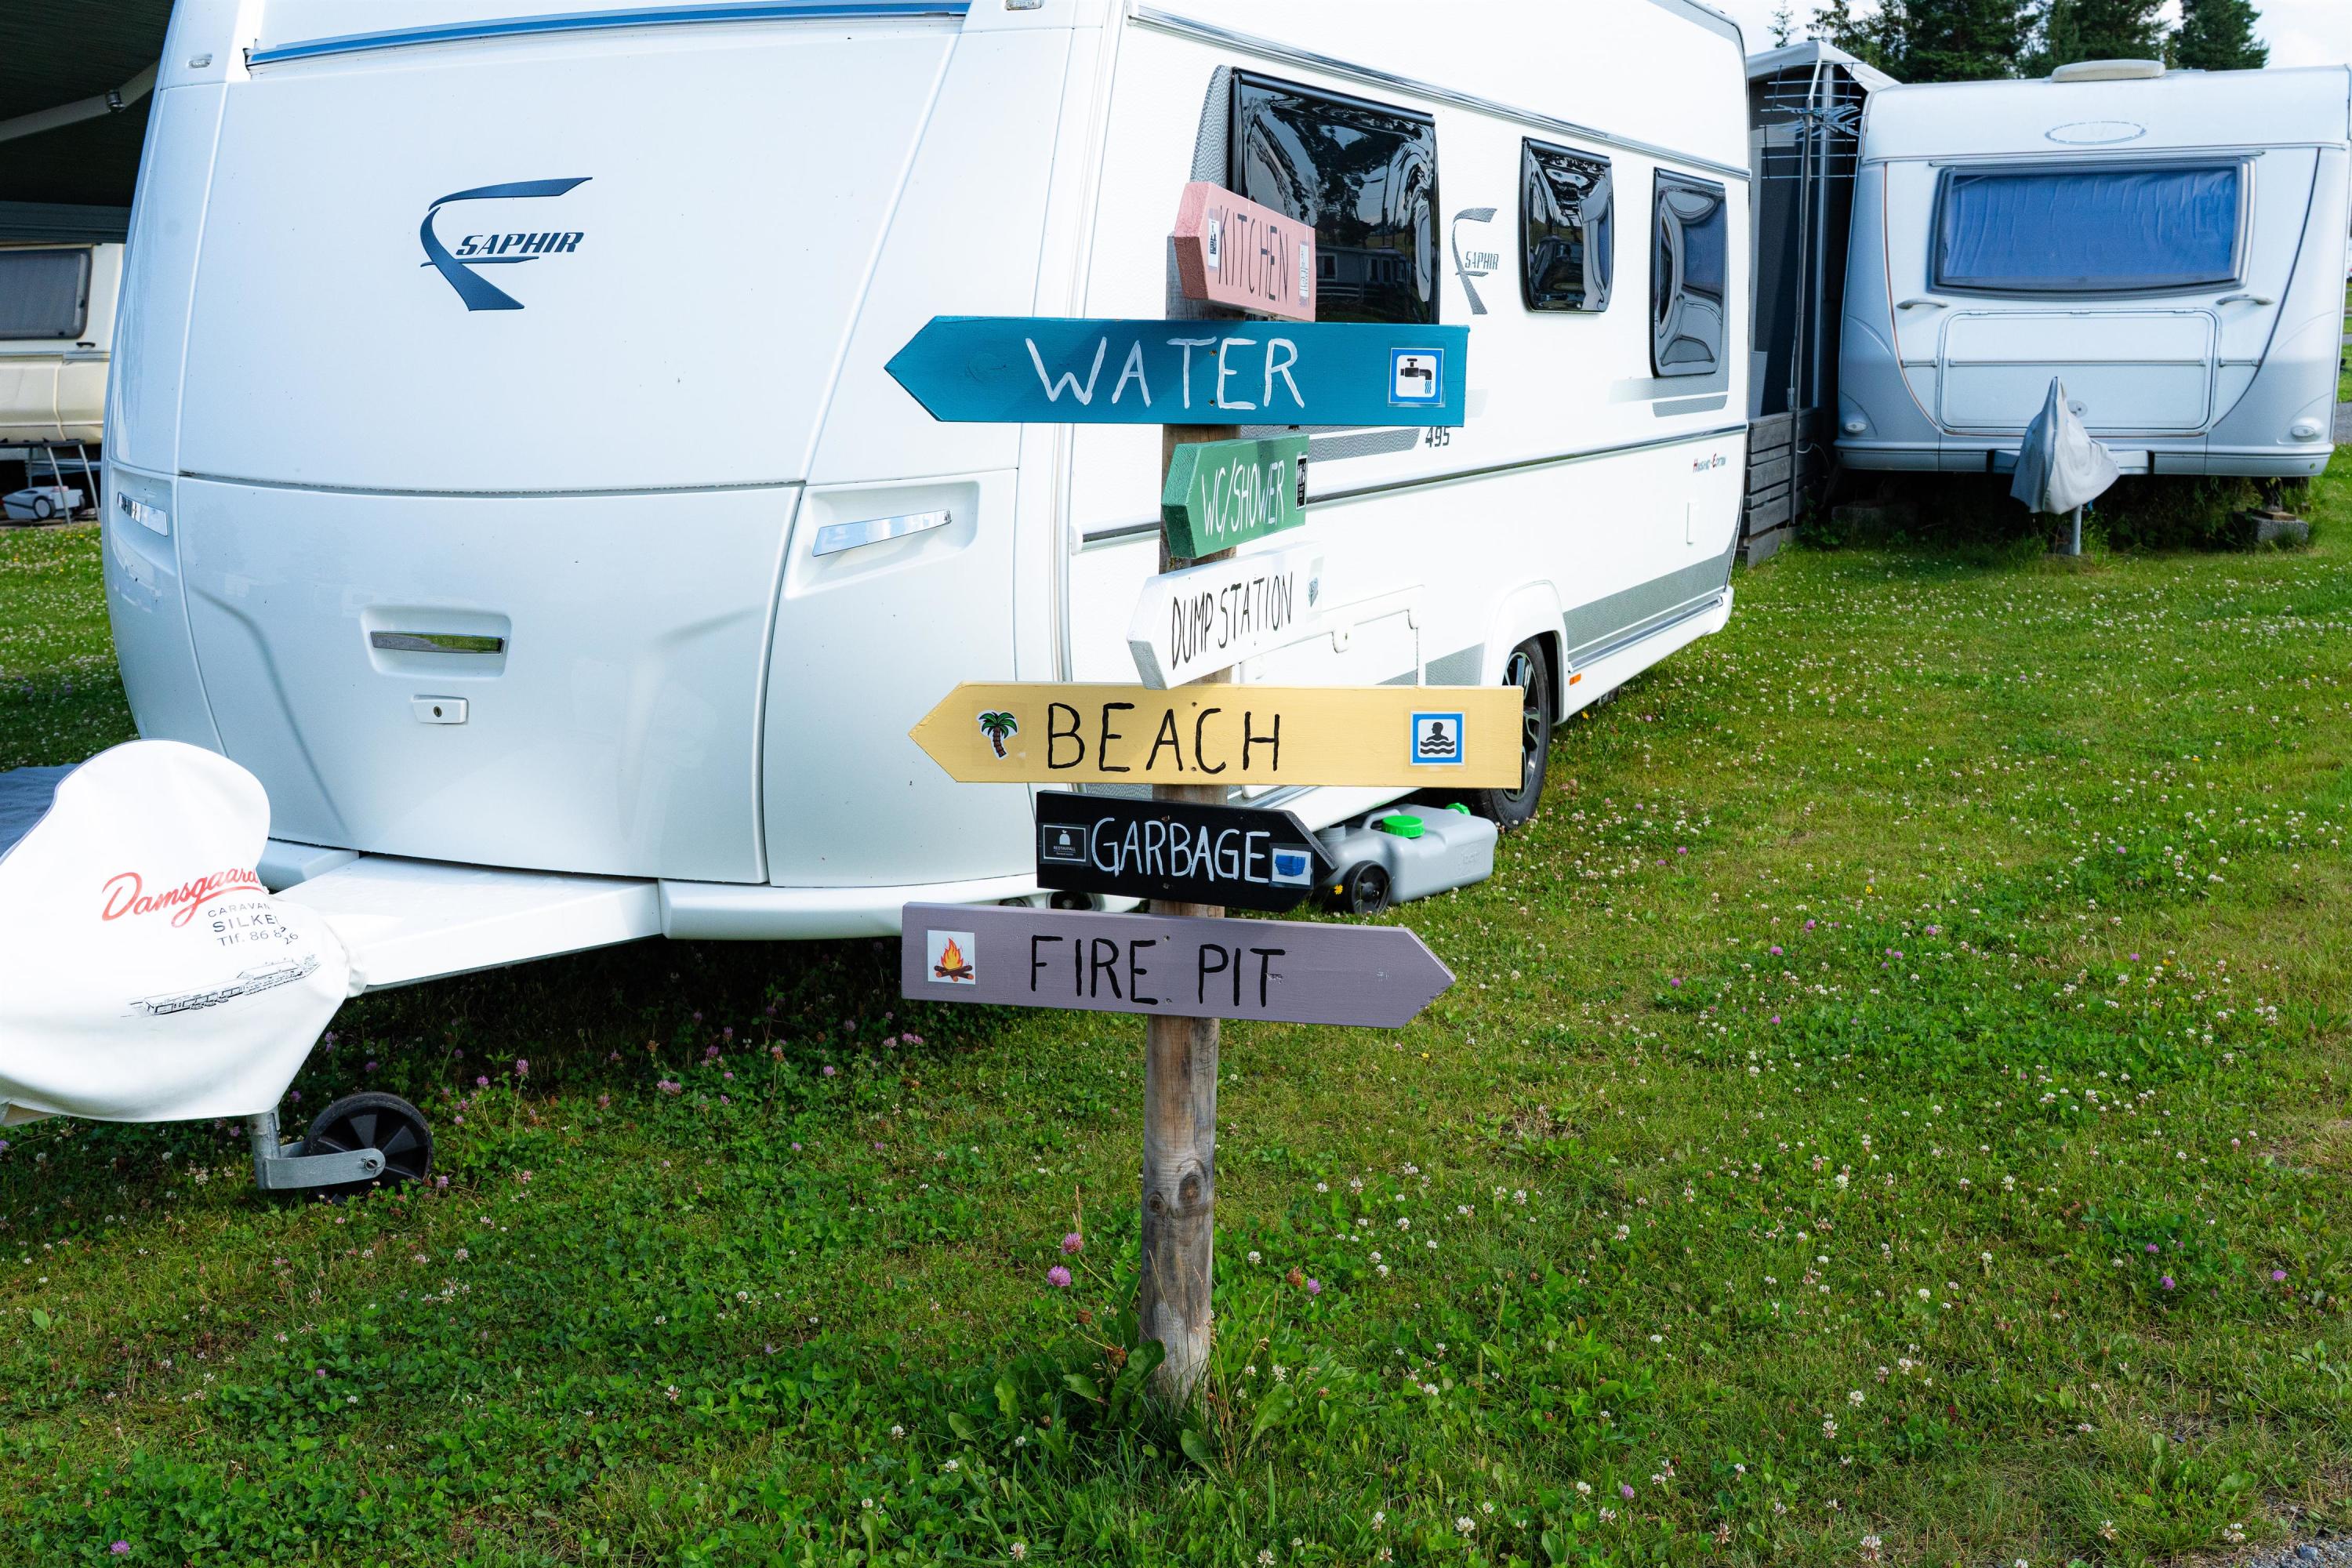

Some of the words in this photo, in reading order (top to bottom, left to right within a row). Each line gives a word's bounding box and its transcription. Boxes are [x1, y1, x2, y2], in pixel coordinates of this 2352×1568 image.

[455, 232, 584, 256] SAPHIR
[1218, 205, 1288, 305] KITCHEN
[1465, 251, 1499, 270] SAPHIR
[1025, 336, 1305, 410] WATER
[1425, 426, 1450, 448] 495
[1201, 457, 1285, 543] WC/SHOWER
[1171, 591, 1213, 670] DUMP
[1218, 571, 1293, 649] STATION
[1047, 702, 1281, 774] BEACH
[1091, 818, 1271, 884] GARBAGE
[250, 930, 269, 941] 86
[1030, 935, 1159, 1005] FIRE
[1197, 944, 1286, 1007] PIT
